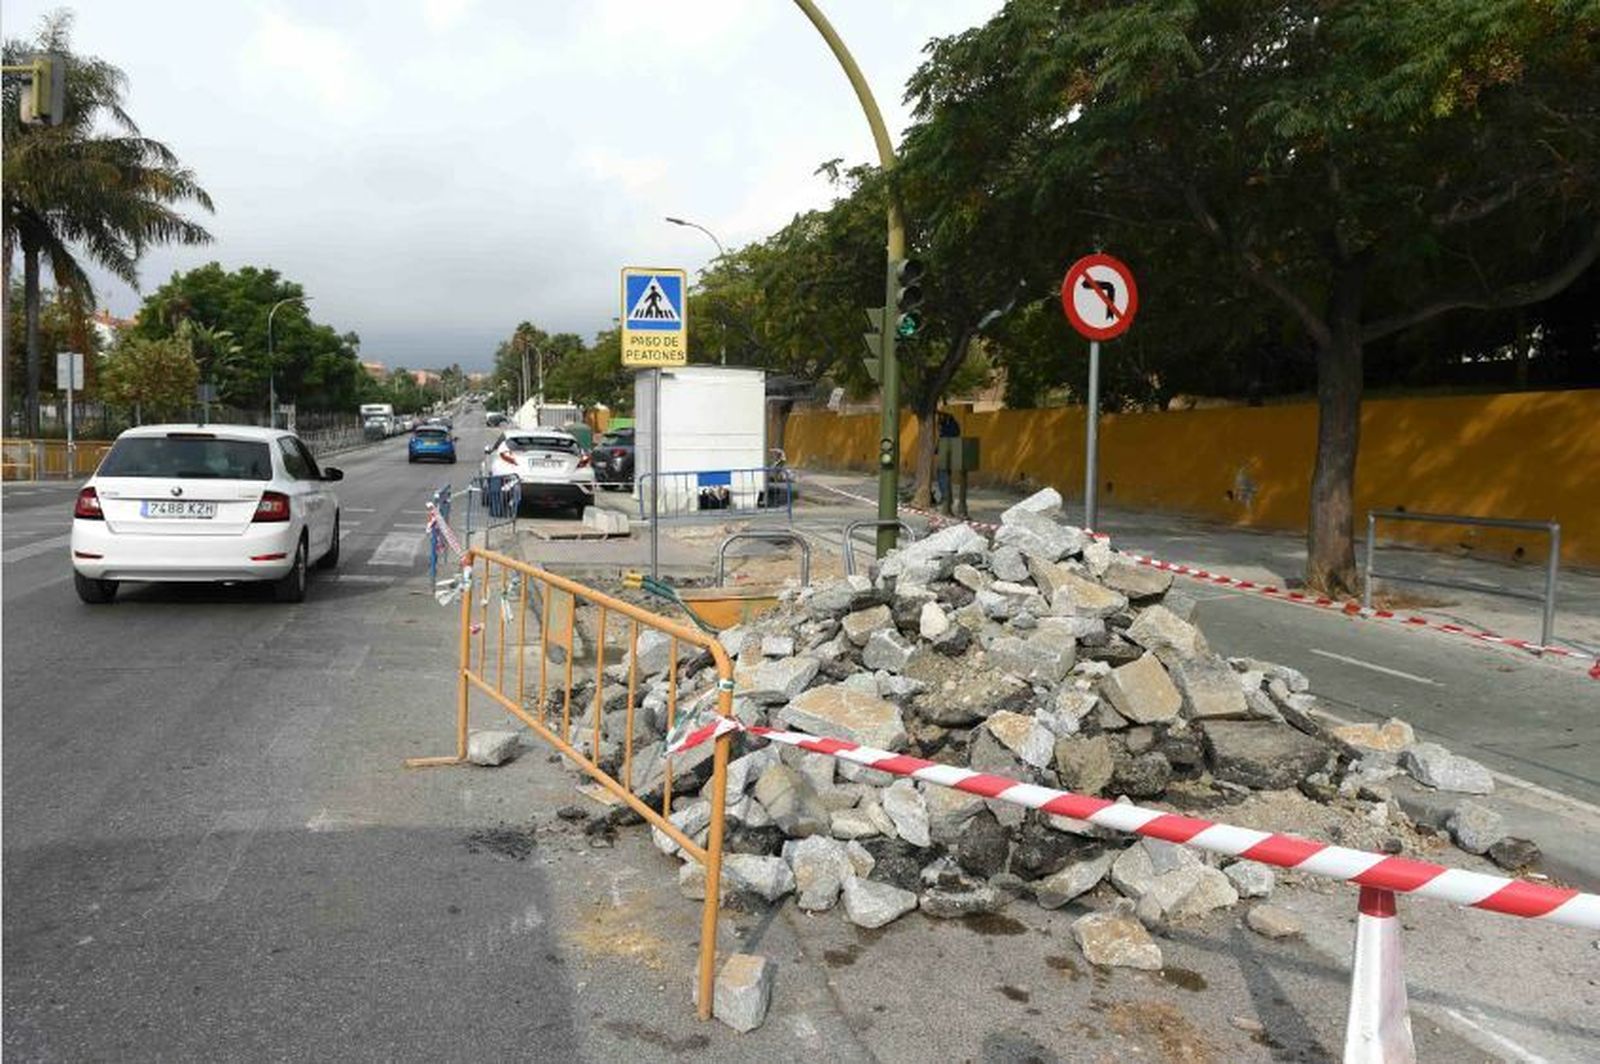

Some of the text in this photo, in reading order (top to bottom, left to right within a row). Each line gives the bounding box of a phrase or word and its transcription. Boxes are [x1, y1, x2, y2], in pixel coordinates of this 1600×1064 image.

[630, 336, 679, 347] PASO DE
[626, 350, 685, 360] PEATONES
[151, 503, 184, 514] 7488
